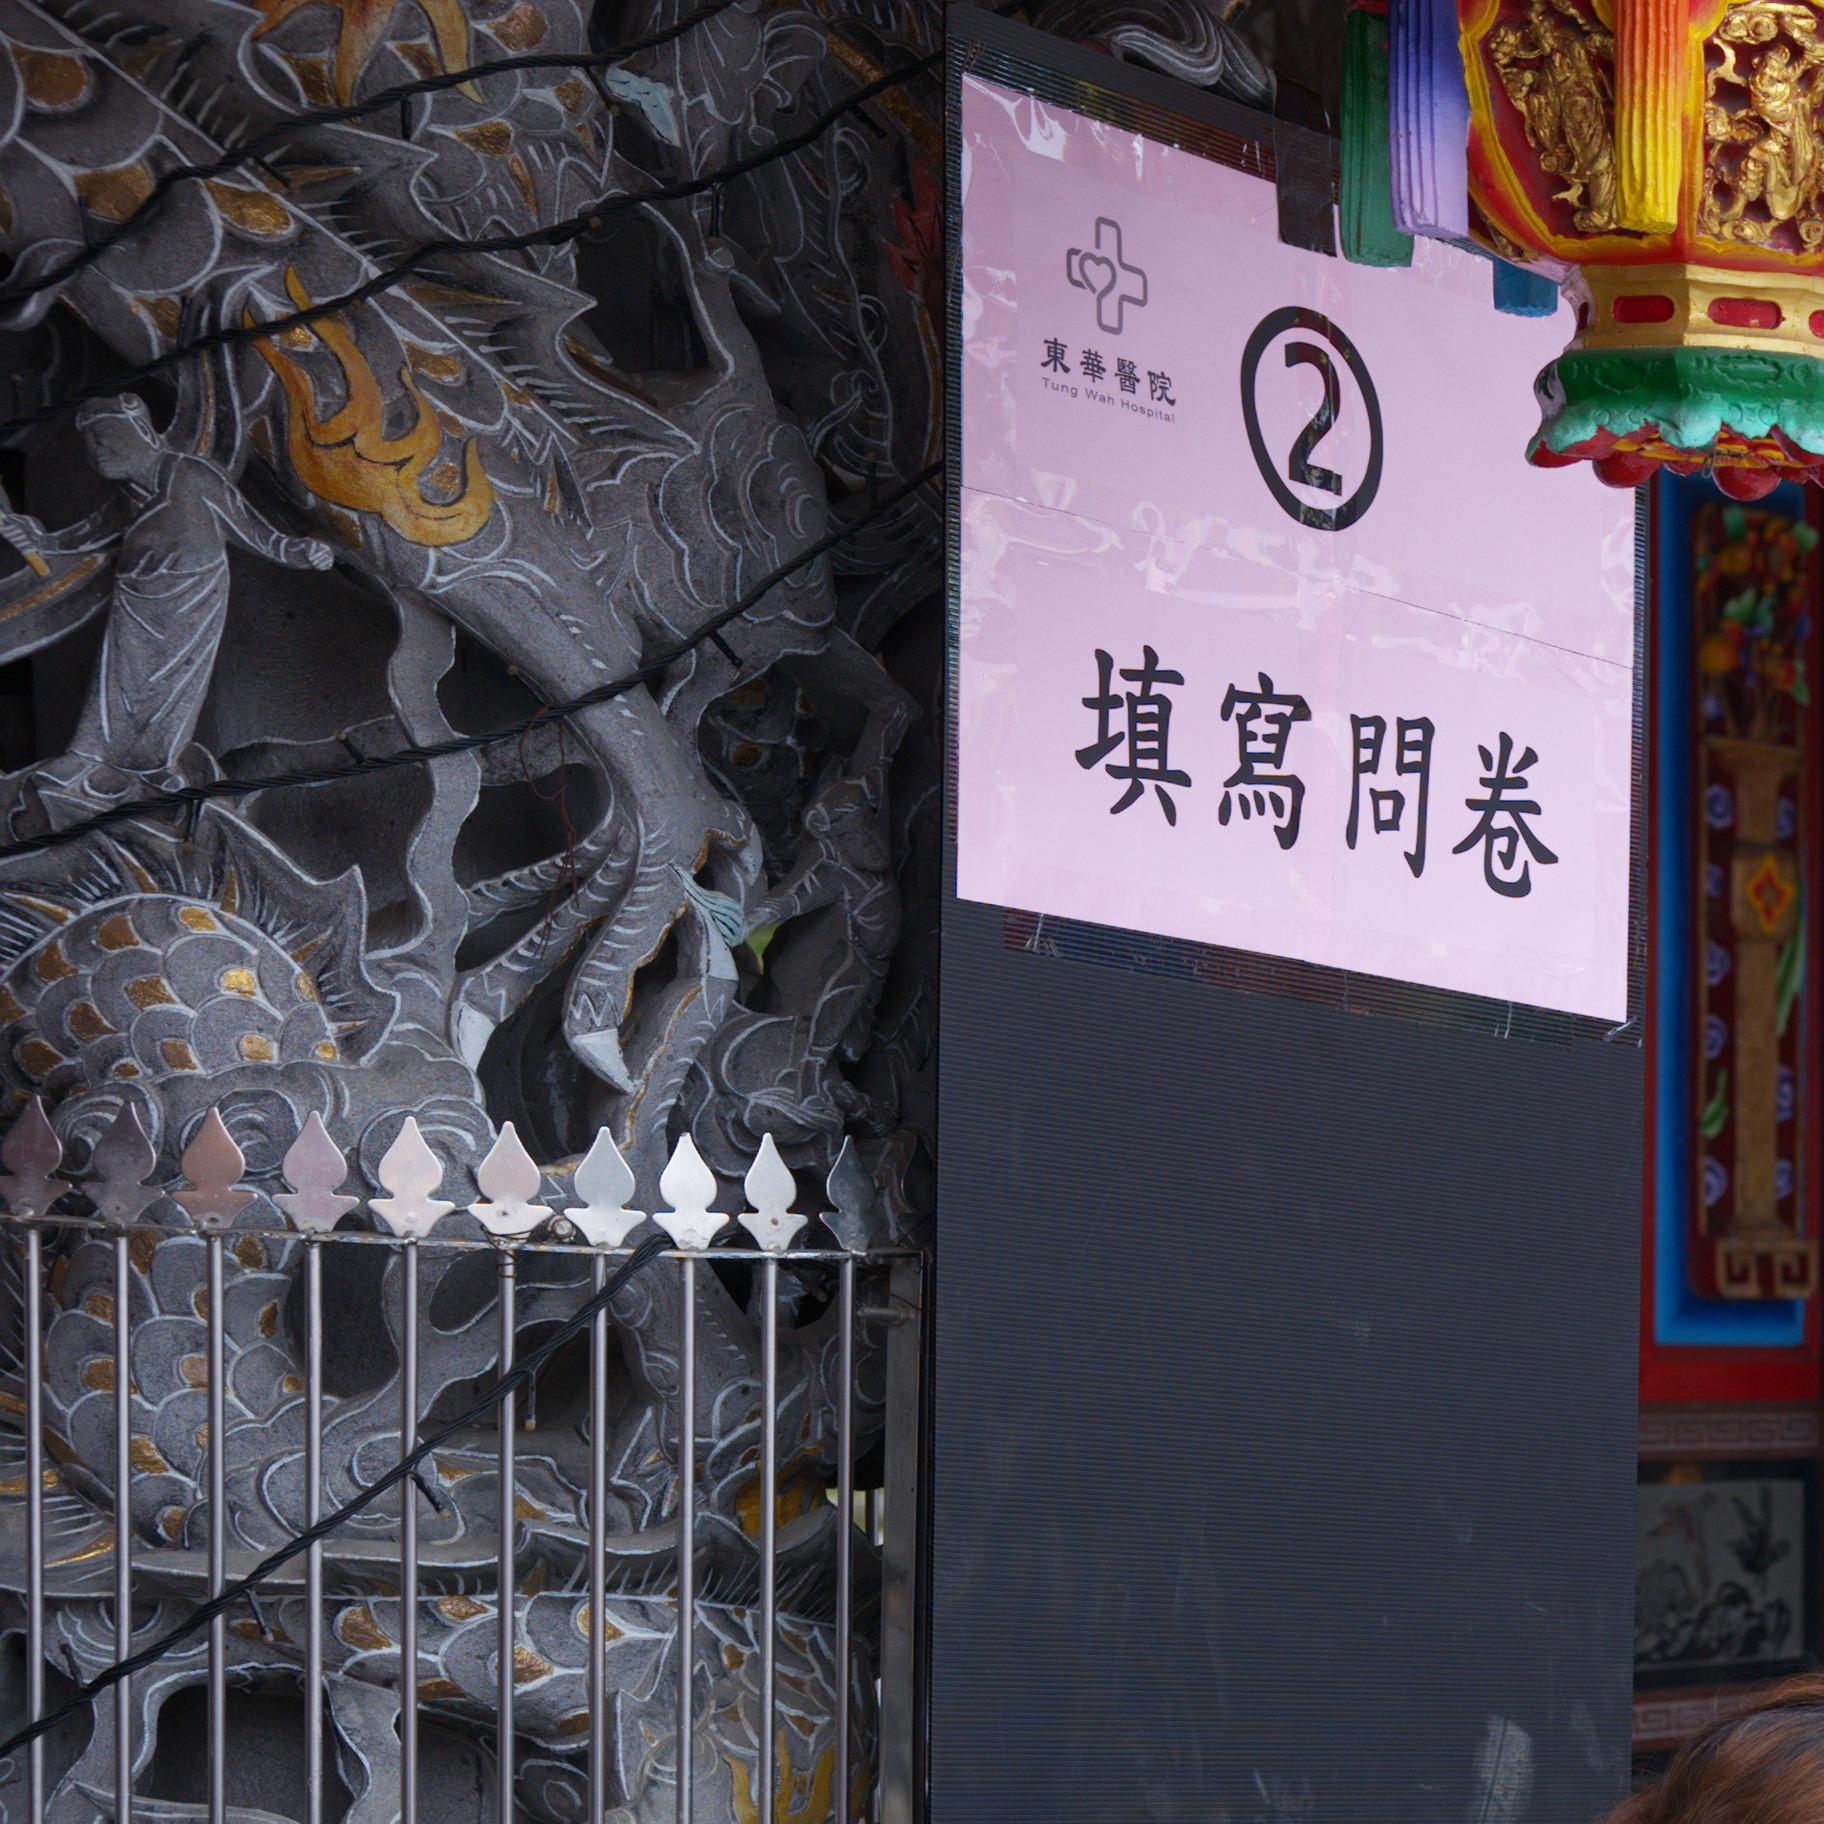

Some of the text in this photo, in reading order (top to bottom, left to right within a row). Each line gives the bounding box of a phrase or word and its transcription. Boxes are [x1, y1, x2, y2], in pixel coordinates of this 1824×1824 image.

[1040, 338, 1176, 406] 東華醫院
[1042, 377, 1175, 423] Tung Wah Hospital
[1075, 644, 1560, 898] 填寫問卷
